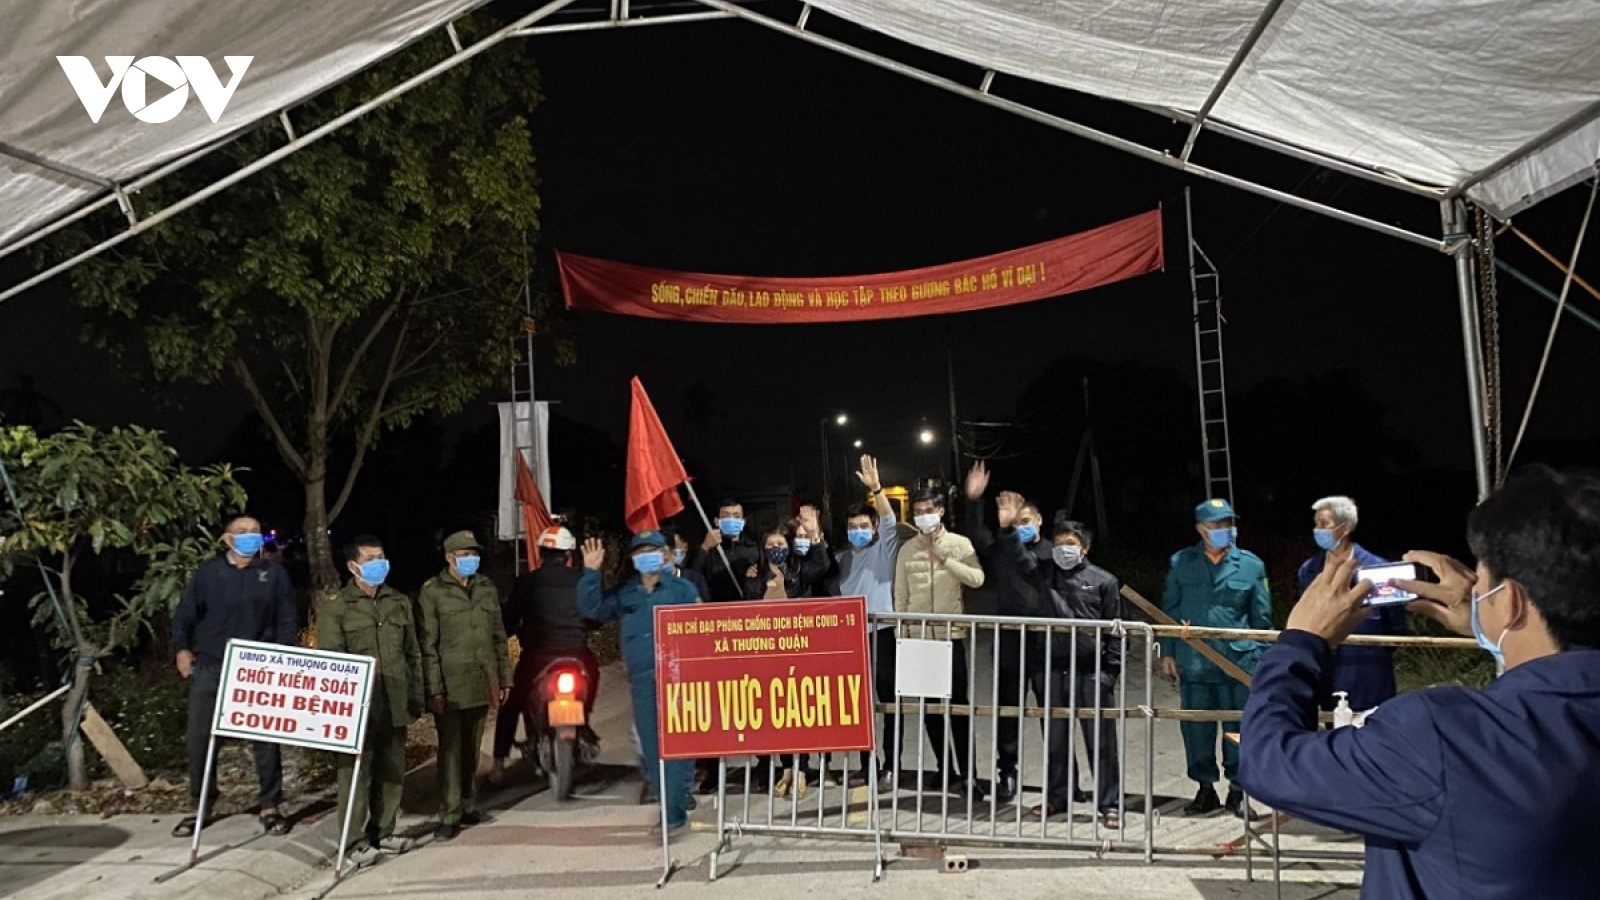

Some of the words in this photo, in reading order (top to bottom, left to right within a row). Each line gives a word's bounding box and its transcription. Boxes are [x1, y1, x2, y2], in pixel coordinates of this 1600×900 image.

[748, 290, 770, 307] LAO
[773, 288, 804, 310] ĐỘNG
[808, 288, 822, 307] VÀ
[826, 290, 849, 309] HỌC
[852, 285, 874, 307] TẬP
[879, 285, 907, 303] THEO
[954, 273, 977, 295] BÁC
[667, 621, 683, 635] BAN
[684, 617, 698, 635] CHỈ
[699, 619, 715, 636] ĐẠO
[716, 616, 743, 632] PHÒNG
[744, 614, 771, 631] CHỐNG
[772, 617, 792, 633] DỊCH
[792, 613, 814, 632] BỆNH
[815, 614, 838, 628] COVID
[845, 613, 856, 627] 19
[239, 651, 267, 662] UBND
[732, 636, 775, 654] THƯỢNG
[778, 634, 809, 652] QUẬN
[236, 665, 275, 686] CHỐT
[278, 669, 316, 691] KIỂM
[319, 675, 358, 697] SOÁT
[232, 688, 286, 709] DỊCH
[292, 695, 354, 718] BỆNH
[666, 681, 712, 734] KHU
[717, 673, 764, 743] VỰC
[769, 665, 832, 730] CÁCH
[837, 674, 861, 726] LY
[230, 711, 297, 733] COVID
[322, 723, 349, 741] 19
